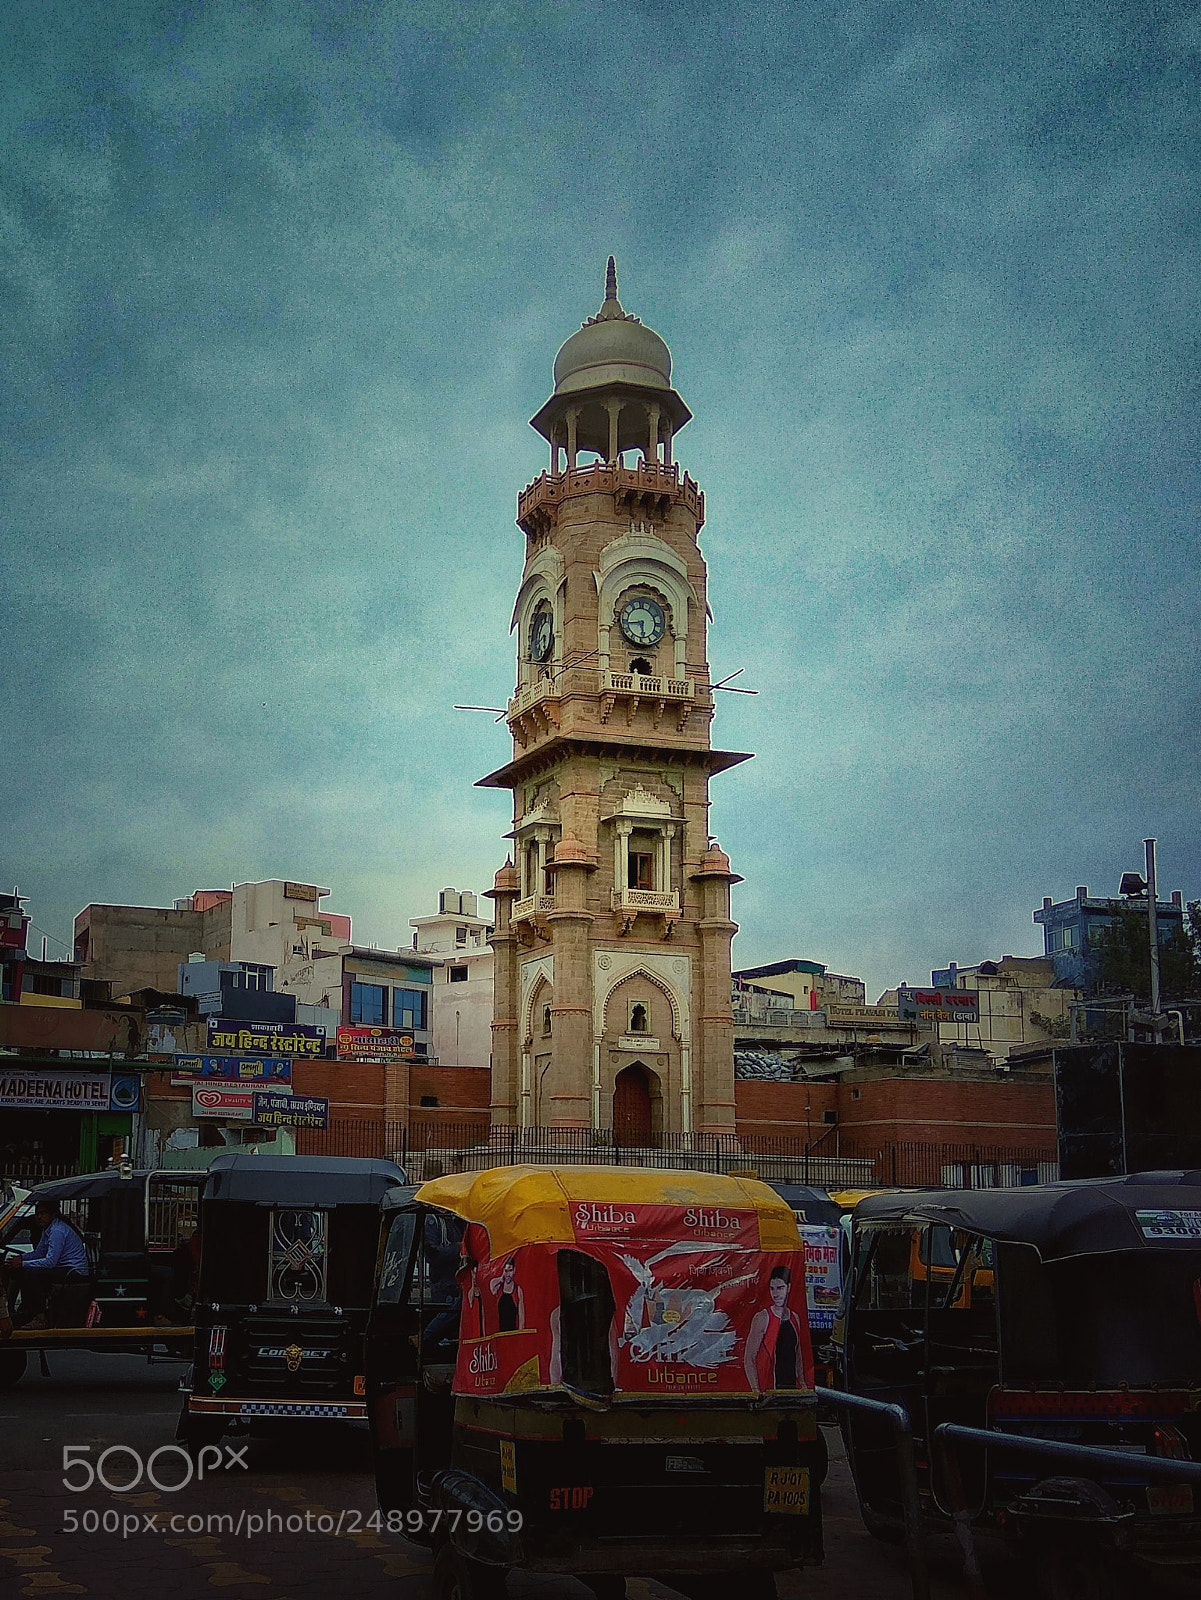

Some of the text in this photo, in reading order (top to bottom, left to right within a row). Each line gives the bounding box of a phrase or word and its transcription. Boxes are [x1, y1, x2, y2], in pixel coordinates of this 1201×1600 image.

[830, 1005, 854, 1016] HOTEL
[212, 1031, 238, 1048] जय
[238, 1029, 270, 1050] हिन्द
[64, 1080, 108, 1100] HOTEL
[258, 1112, 272, 1124] जय
[274, 1110, 292, 1125] हिन्द
[575, 1204, 637, 1224] Shiba
[682, 1208, 742, 1230] Shiba
[692, 1229, 735, 1238] Urbance
[823, 1241, 838, 1264] मेला
[648, 1366, 718, 1384] Urbance
[550, 1486, 594, 1510] STOP
